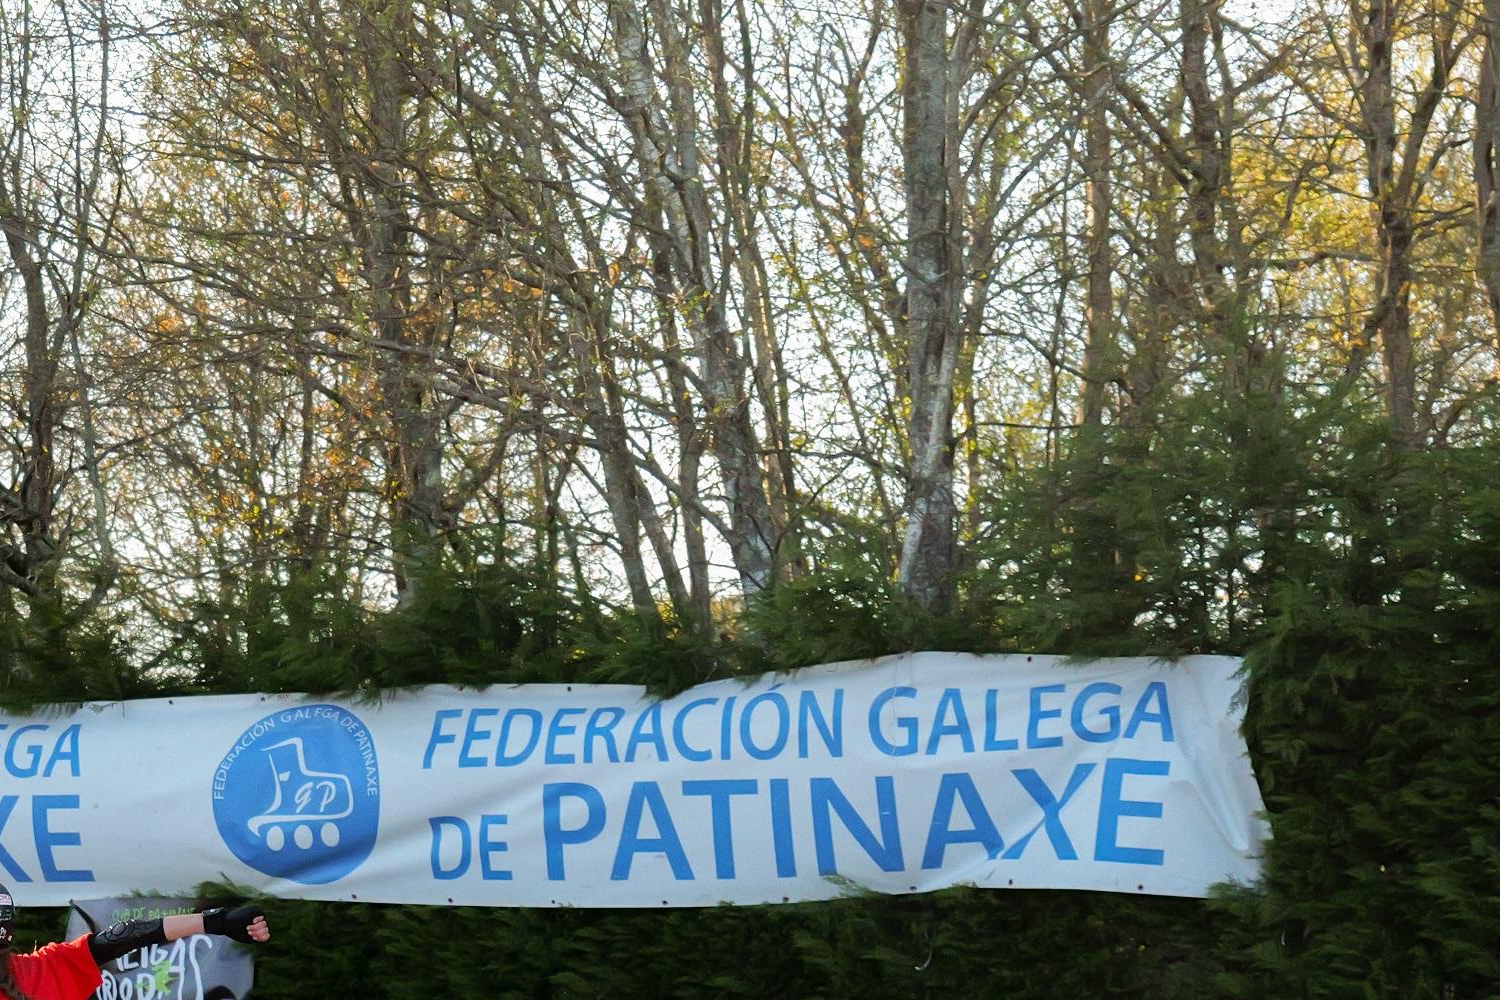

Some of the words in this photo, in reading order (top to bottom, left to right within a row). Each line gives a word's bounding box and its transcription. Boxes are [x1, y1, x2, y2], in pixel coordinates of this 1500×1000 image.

[354, 730, 379, 797] PATINAXE
[422, 682, 845, 770] FEDERACIÓN
[868, 680, 1176, 757] GALEGA
[429, 814, 513, 882] DE
[541, 757, 1172, 882] PATINAXE
